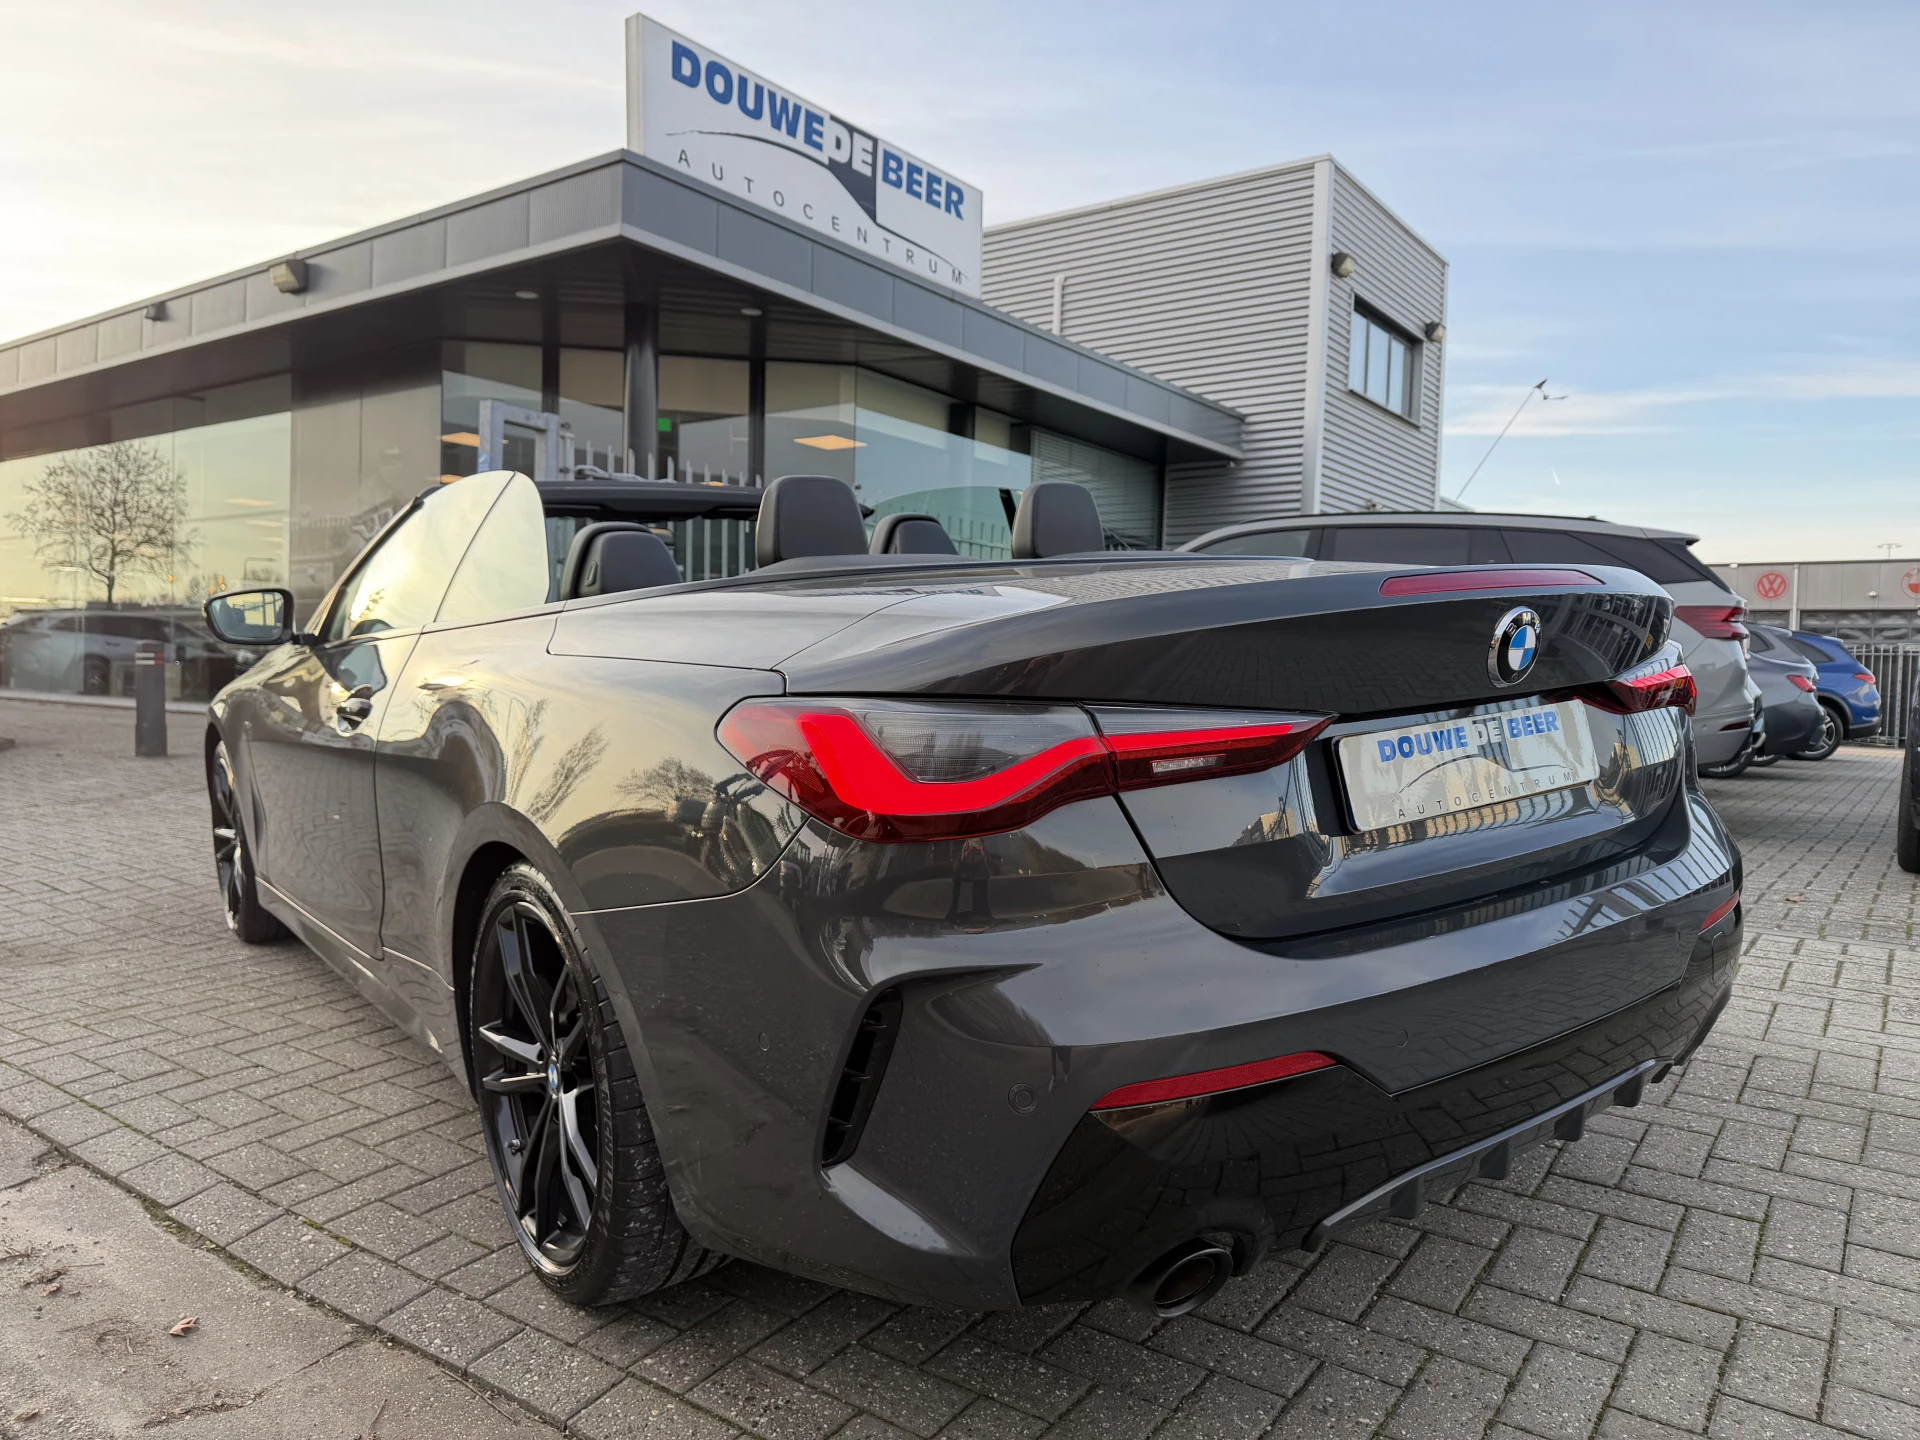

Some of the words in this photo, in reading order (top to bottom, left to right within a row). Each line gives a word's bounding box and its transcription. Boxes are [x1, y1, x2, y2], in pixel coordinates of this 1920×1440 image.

[671, 40, 825, 153] DOUWE
[826, 117, 873, 177] DE
[881, 148, 964, 221] BEER
[677, 148, 963, 285] AUTOCENTRUM
[1376, 725, 1469, 763] DOUWE
[1474, 720, 1501, 746] DE
[1506, 711, 1560, 739] BEER
[1398, 771, 1572, 819] AUTOCENTRUM
